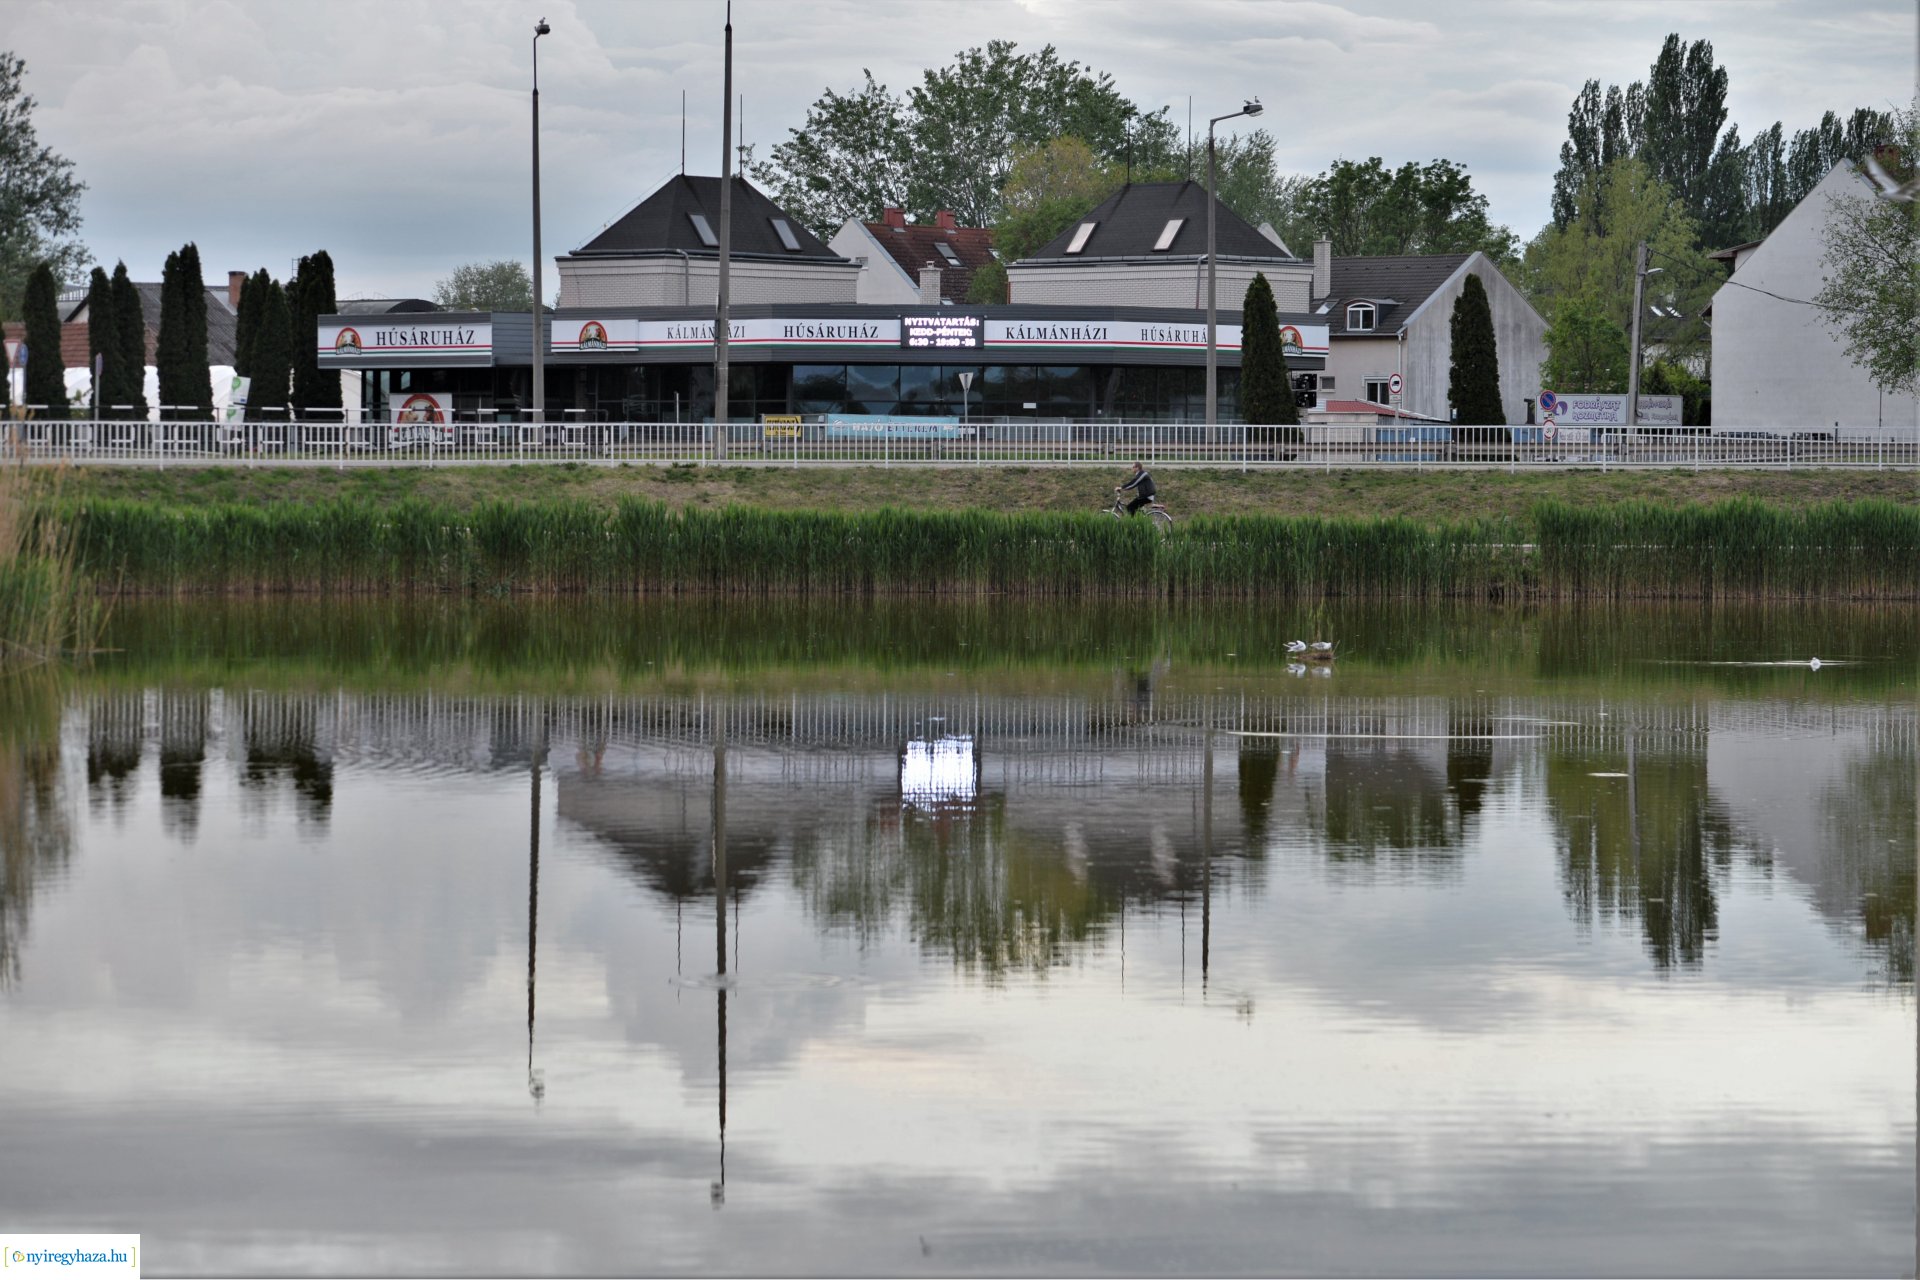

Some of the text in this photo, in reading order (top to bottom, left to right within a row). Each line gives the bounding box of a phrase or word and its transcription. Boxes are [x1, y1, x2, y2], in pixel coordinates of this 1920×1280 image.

[904, 316, 980, 326] NYITVATARTÁS:
[376, 325, 476, 346] HÚSÁRUHÁZ
[667, 322, 880, 339] KÁLMÁNÁZI HÚSÁRUHÁZ
[1005, 324, 1208, 343] KÁLMÁNHÁZI HÚSÁRUHÁ
[1572, 396, 1621, 411] FODRÁSZAT
[1572, 411, 1618, 422] KOZMETIKA
